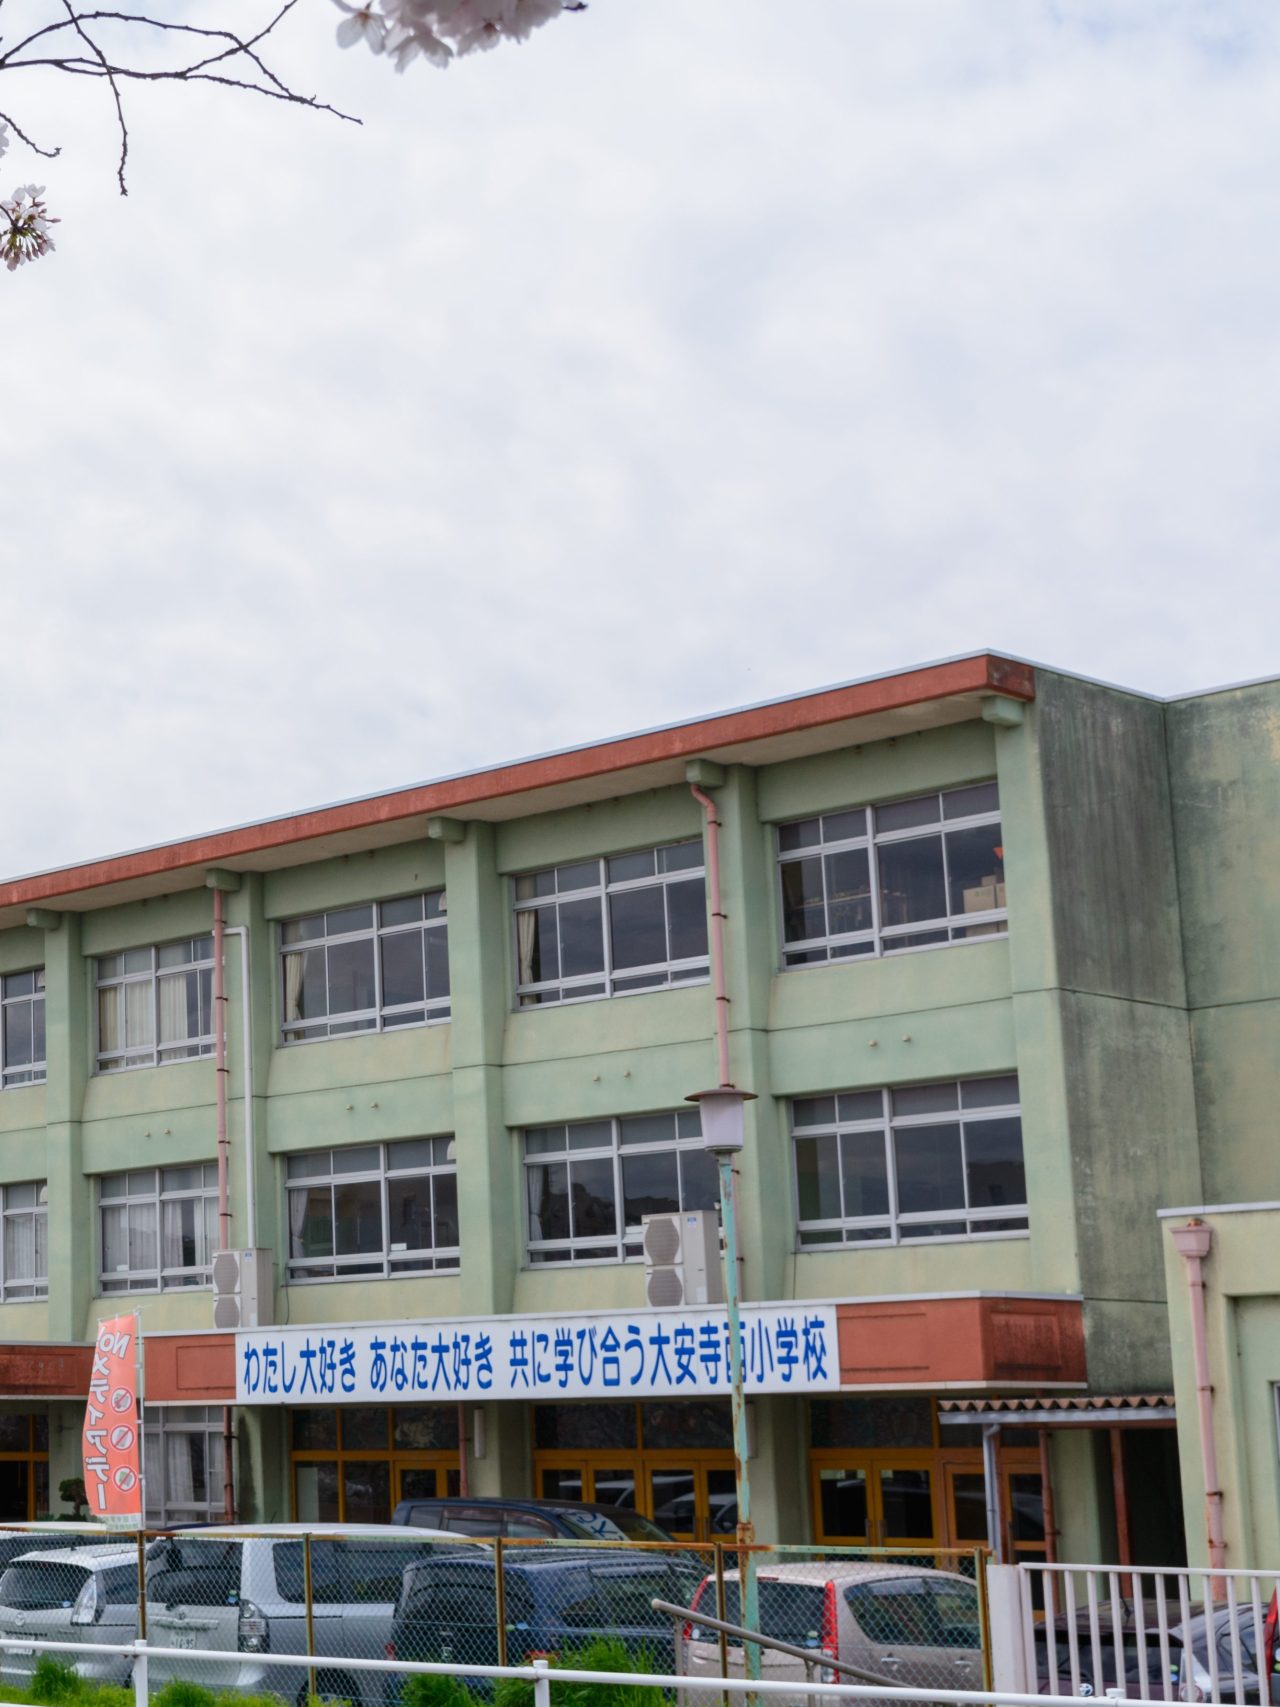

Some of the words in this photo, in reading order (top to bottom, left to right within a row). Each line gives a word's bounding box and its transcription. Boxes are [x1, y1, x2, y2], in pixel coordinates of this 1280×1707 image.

[244, 1337, 356, 1395] わたし大好き
[370, 1331, 493, 1392] あなた大好き
